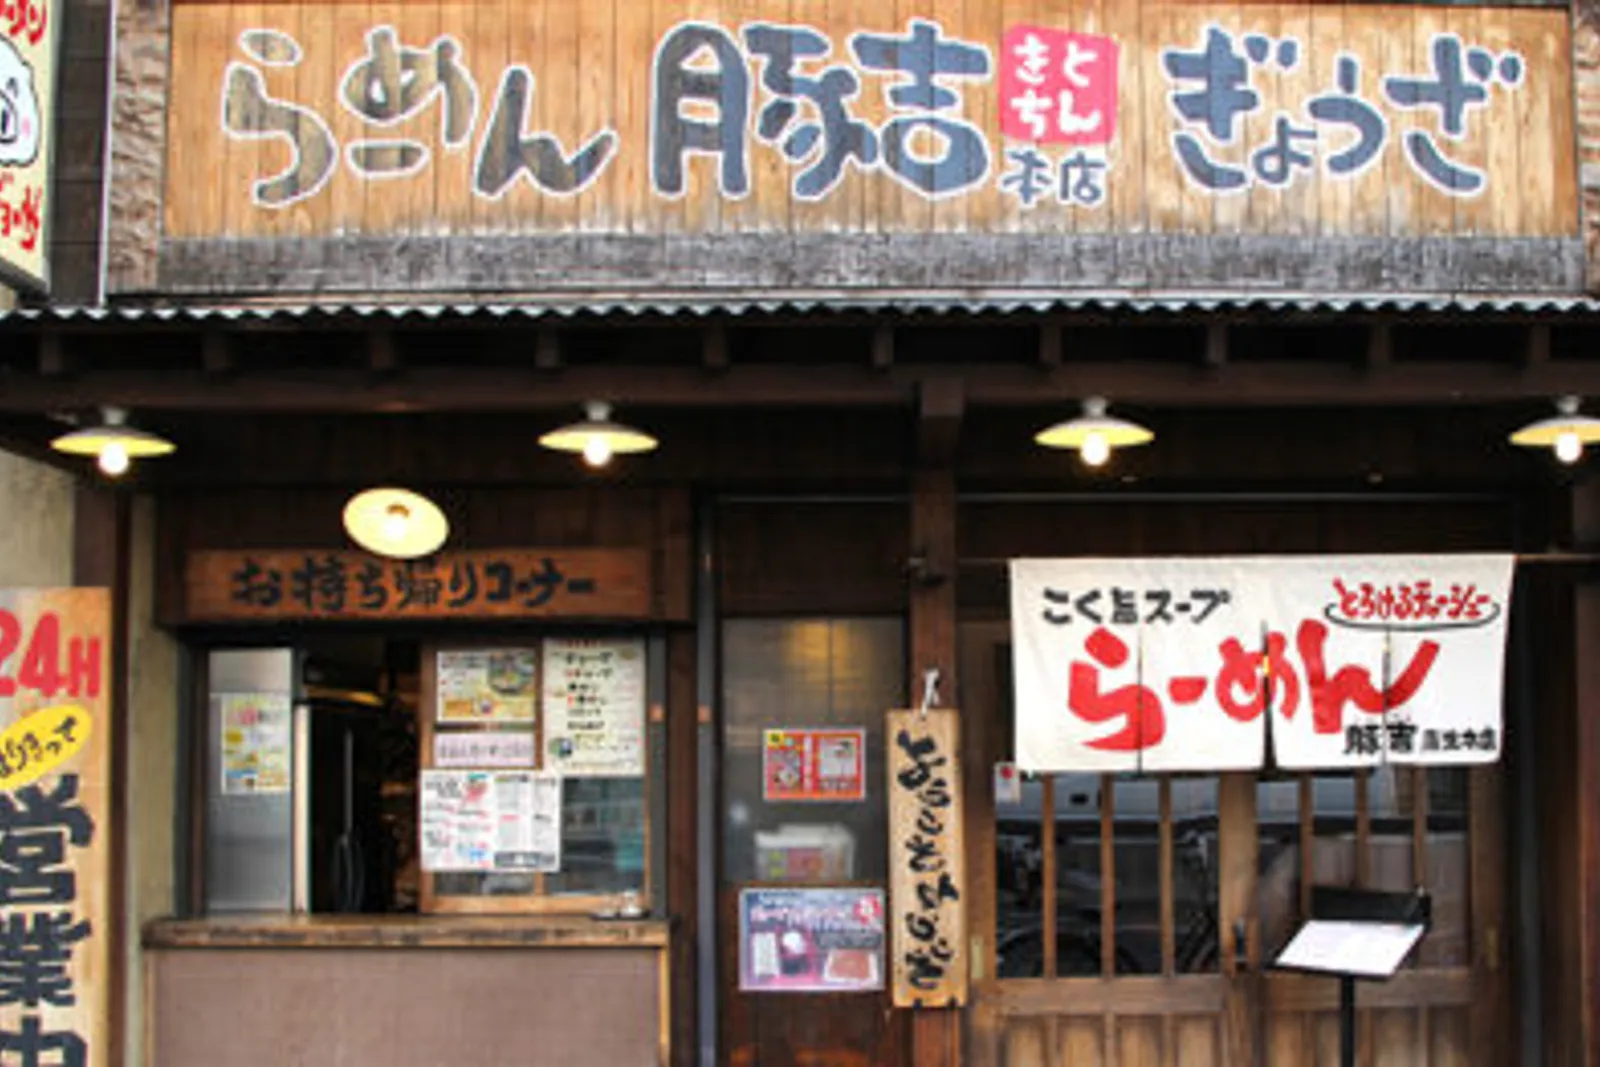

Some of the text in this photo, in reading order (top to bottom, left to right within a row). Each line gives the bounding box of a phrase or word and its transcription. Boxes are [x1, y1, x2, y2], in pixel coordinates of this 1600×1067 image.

[650, 20, 992, 202] 豚吉
[1159, 24, 1525, 195] ぎょうざ
[999, 148, 1110, 205] 本店
[233, 557, 597, 612] お持ち帰りコーナー
[1042, 586, 1232, 626] こく旨スープ
[1067, 618, 1441, 752] らーめん
